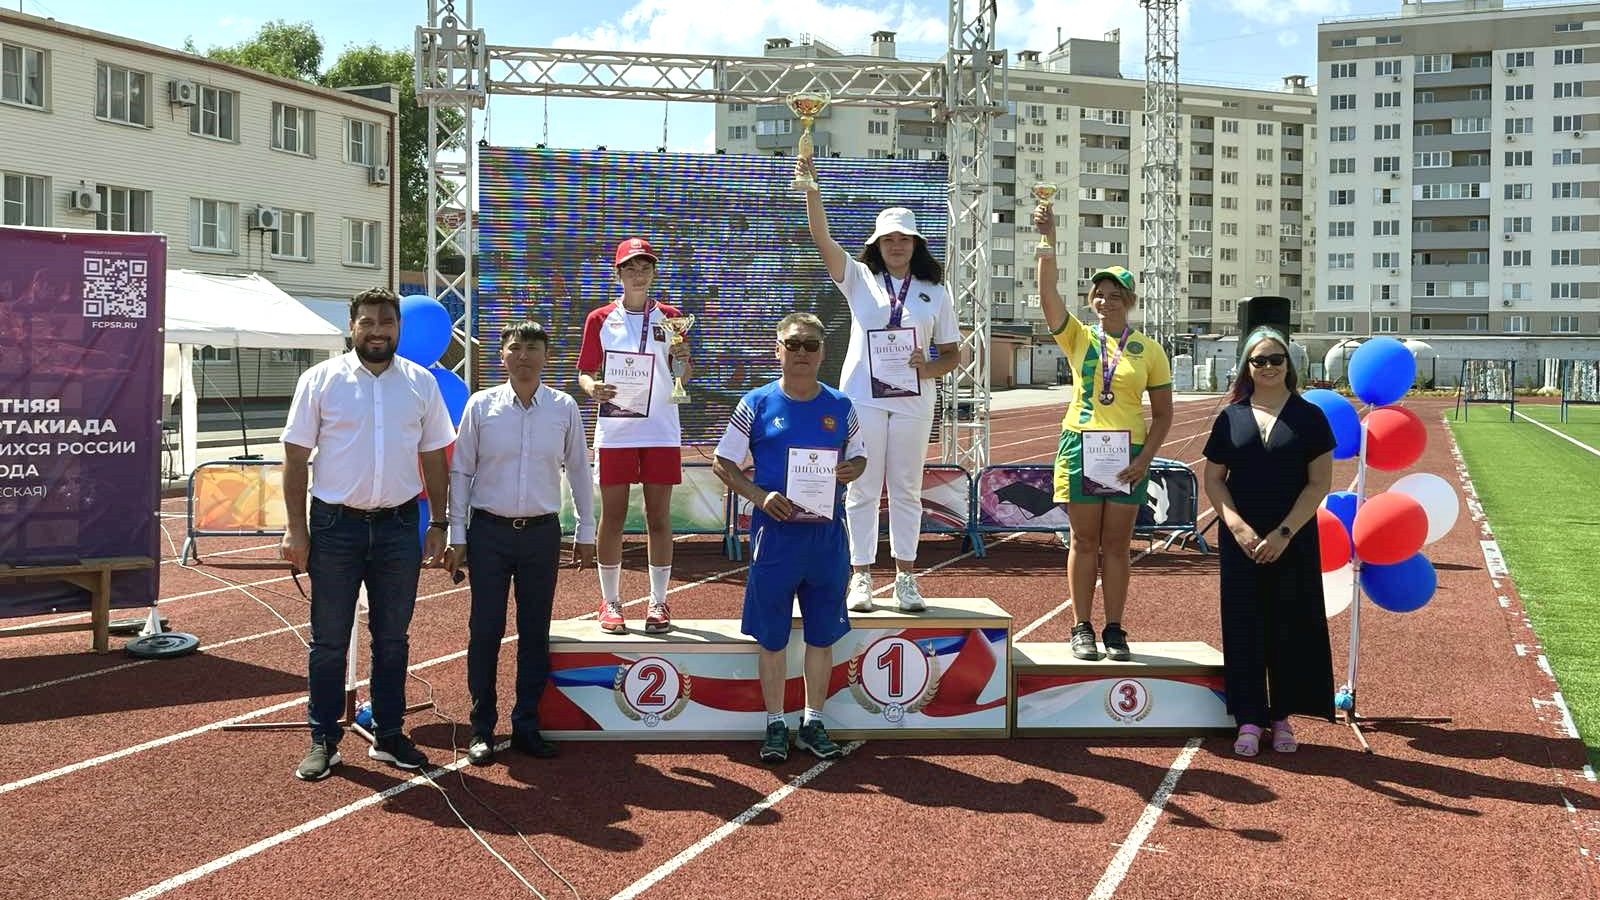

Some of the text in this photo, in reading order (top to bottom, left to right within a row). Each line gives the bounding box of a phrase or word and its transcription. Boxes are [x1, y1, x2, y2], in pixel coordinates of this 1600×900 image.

[91, 321, 138, 329] FCPSR.RU
[872, 344, 913, 355] ДИПЛОМ
[607, 368, 650, 378] ДИПЛОМ
[57, 441, 136, 455] РОССИИ
[1086, 446, 1127, 454] ДИПЛОМ
[791, 464, 834, 476] ДИПЛОМ
[877, 643, 904, 698] 1
[636, 664, 667, 706] 2
[1118, 682, 1138, 713] 3
